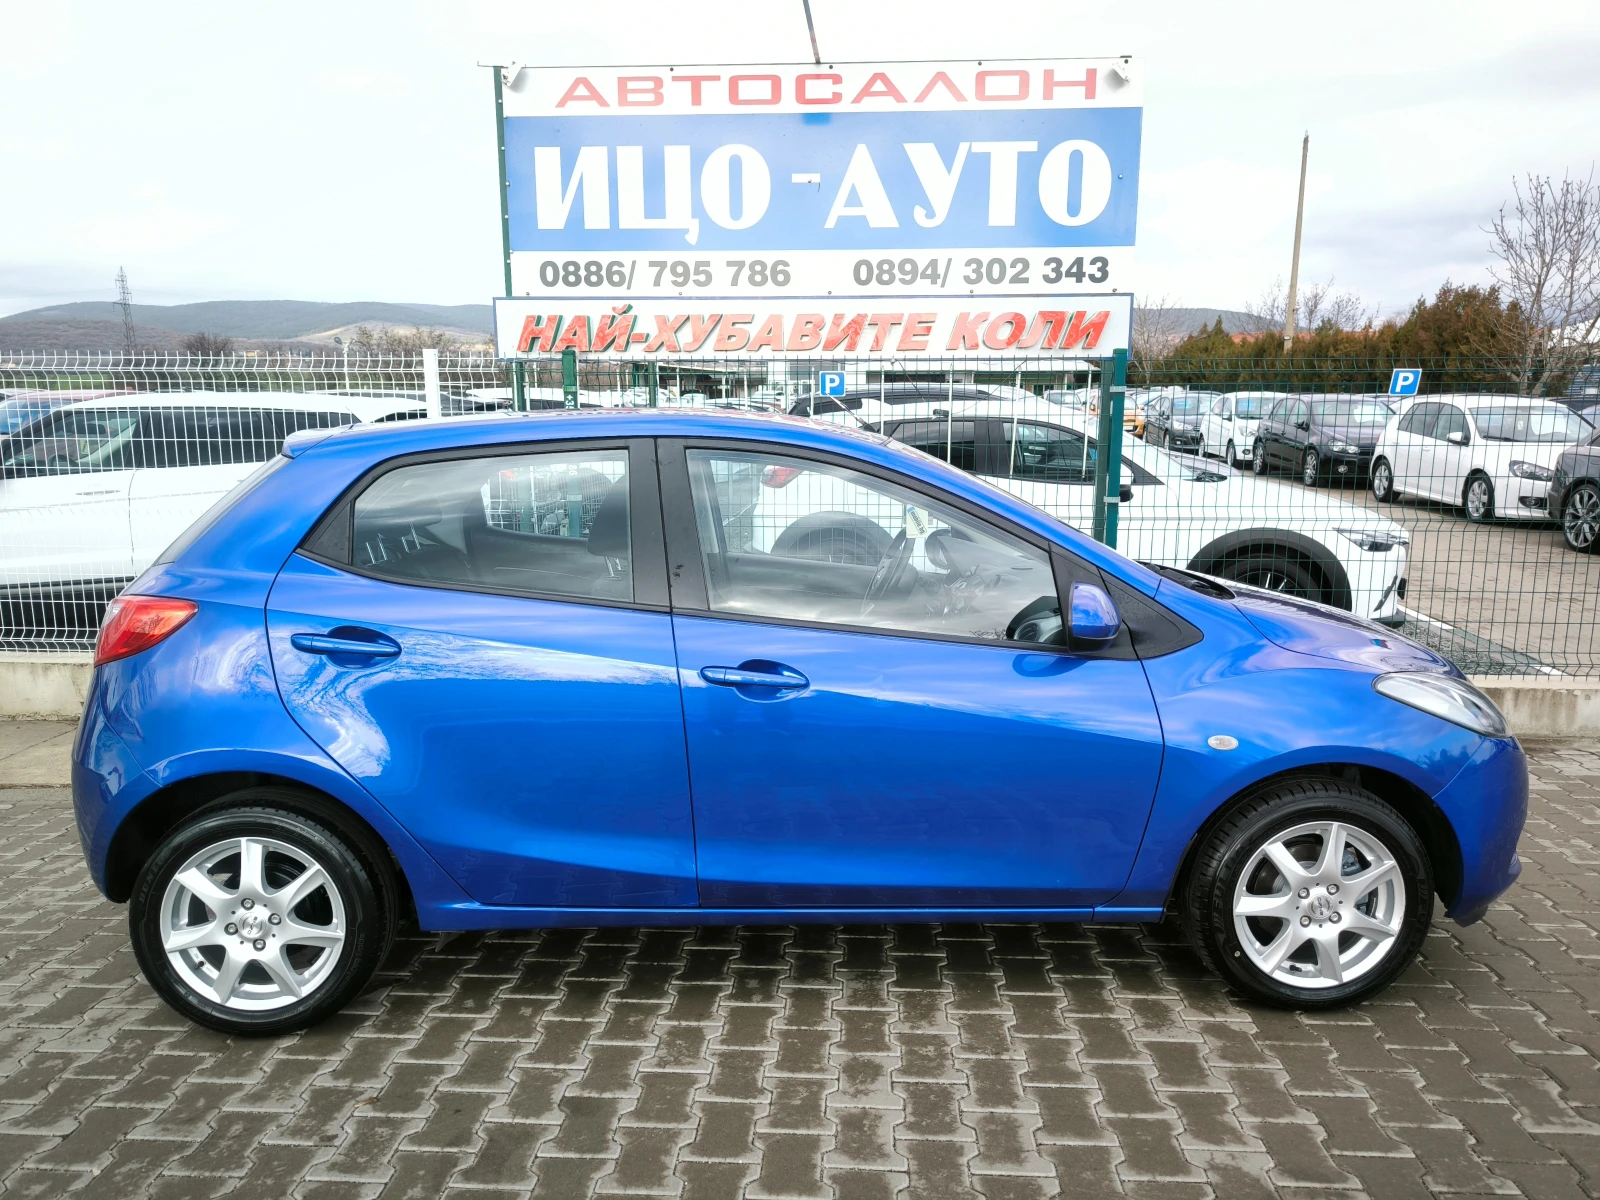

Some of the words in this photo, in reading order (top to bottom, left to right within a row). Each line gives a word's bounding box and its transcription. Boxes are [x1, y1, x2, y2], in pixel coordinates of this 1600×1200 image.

[555, 69, 1097, 108] АВТОСАЛОН
[726, 260, 791, 287] 786
[1041, 256, 1110, 285] 343
[516, 304, 937, 352] НАЙ-ХУБАВИТЕ
[946, 310, 1111, 350] КОЛИ
[825, 374, 840, 394] P
[1395, 372, 1414, 393] P
